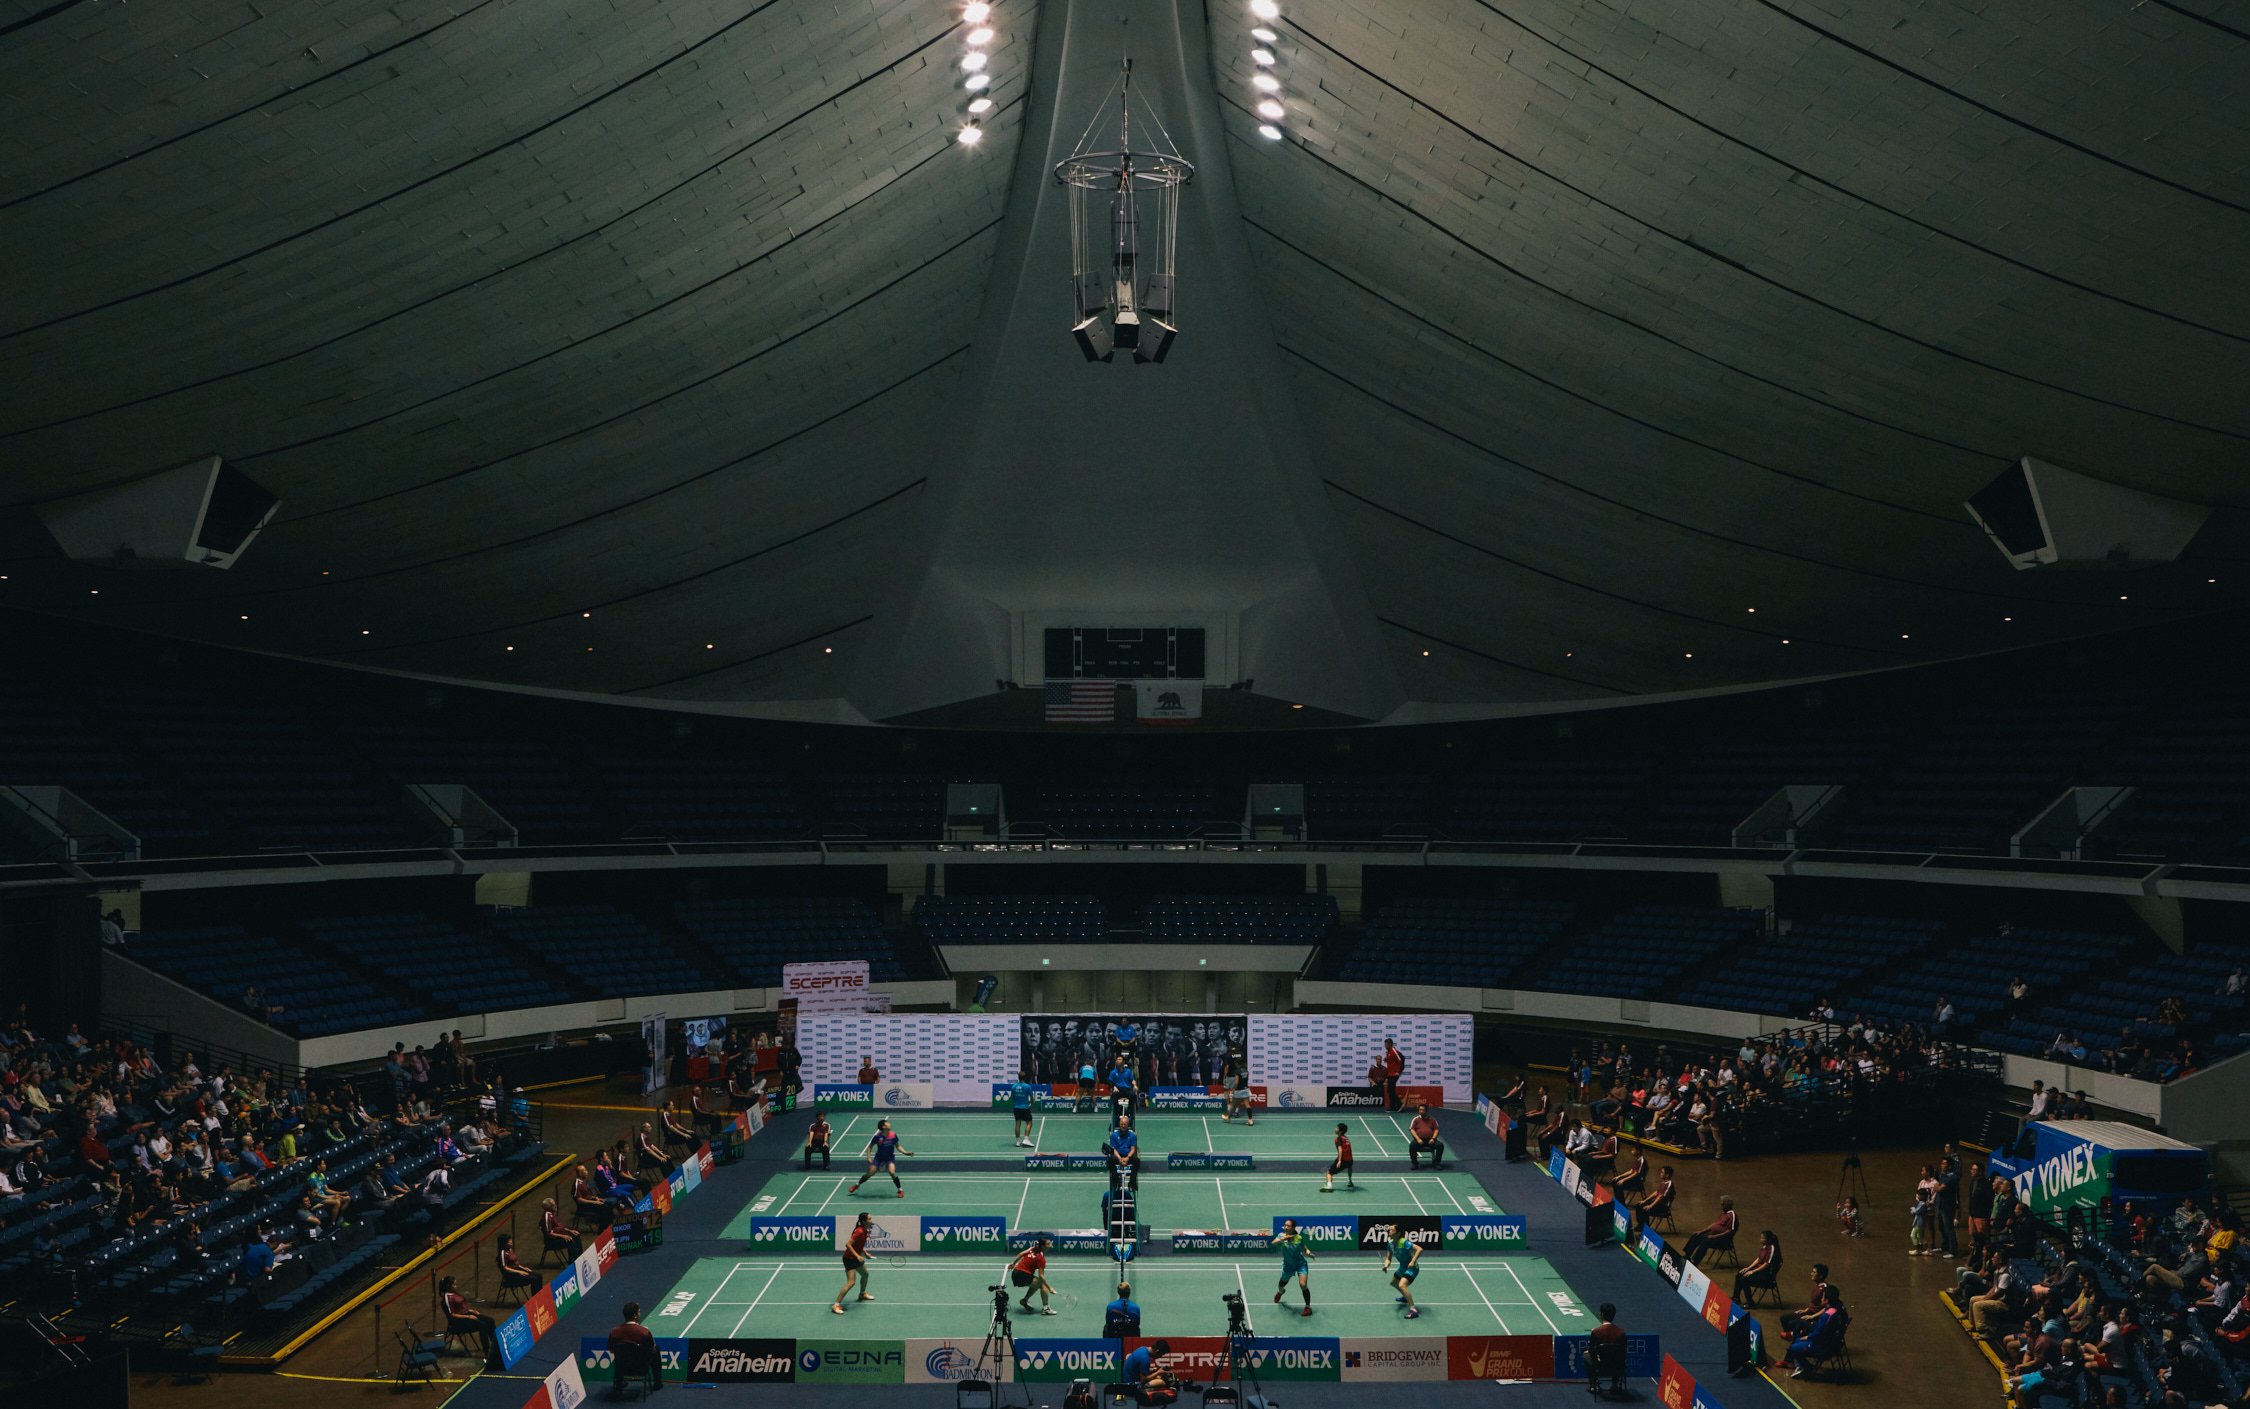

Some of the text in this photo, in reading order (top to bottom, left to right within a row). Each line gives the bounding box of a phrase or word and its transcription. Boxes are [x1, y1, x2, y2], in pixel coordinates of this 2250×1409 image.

[790, 976, 864, 989] SCEPTRE
[838, 1091, 870, 1102] YONEX
[1330, 1093, 1383, 1105] Anaheim
[1041, 1160, 1065, 1168] YONEX
[1085, 1160, 1107, 1168] YONEX
[1181, 1159, 1205, 1167] YONEX
[1225, 1159, 1248, 1167] YONEX
[2038, 1142, 2098, 1201] YONEX
[784, 1226, 829, 1241] YONEX
[954, 1226, 1000, 1241] YONEX
[1305, 1226, 1351, 1241] YONEX
[1475, 1225, 1520, 1240] YONEX
[865, 1240, 904, 1249] BADMINTON
[1080, 1240, 1105, 1249] YONEX
[1192, 1239, 1219, 1248] YONEX
[1243, 1240, 1268, 1248] YONEX
[708, 1348, 741, 1359] Sports
[824, 1351, 902, 1365] EDNA
[1368, 1351, 1442, 1362] BRIDGEWAY
[693, 1352, 792, 1373] Anaheim
[1057, 1351, 1115, 1370] YONEX
[1125, 1352, 1229, 1367] EPTRE
[1273, 1350, 1332, 1369] YONEX
[1488, 1360, 1522, 1369] GRAND
[944, 1369, 993, 1379] BADMINTON
